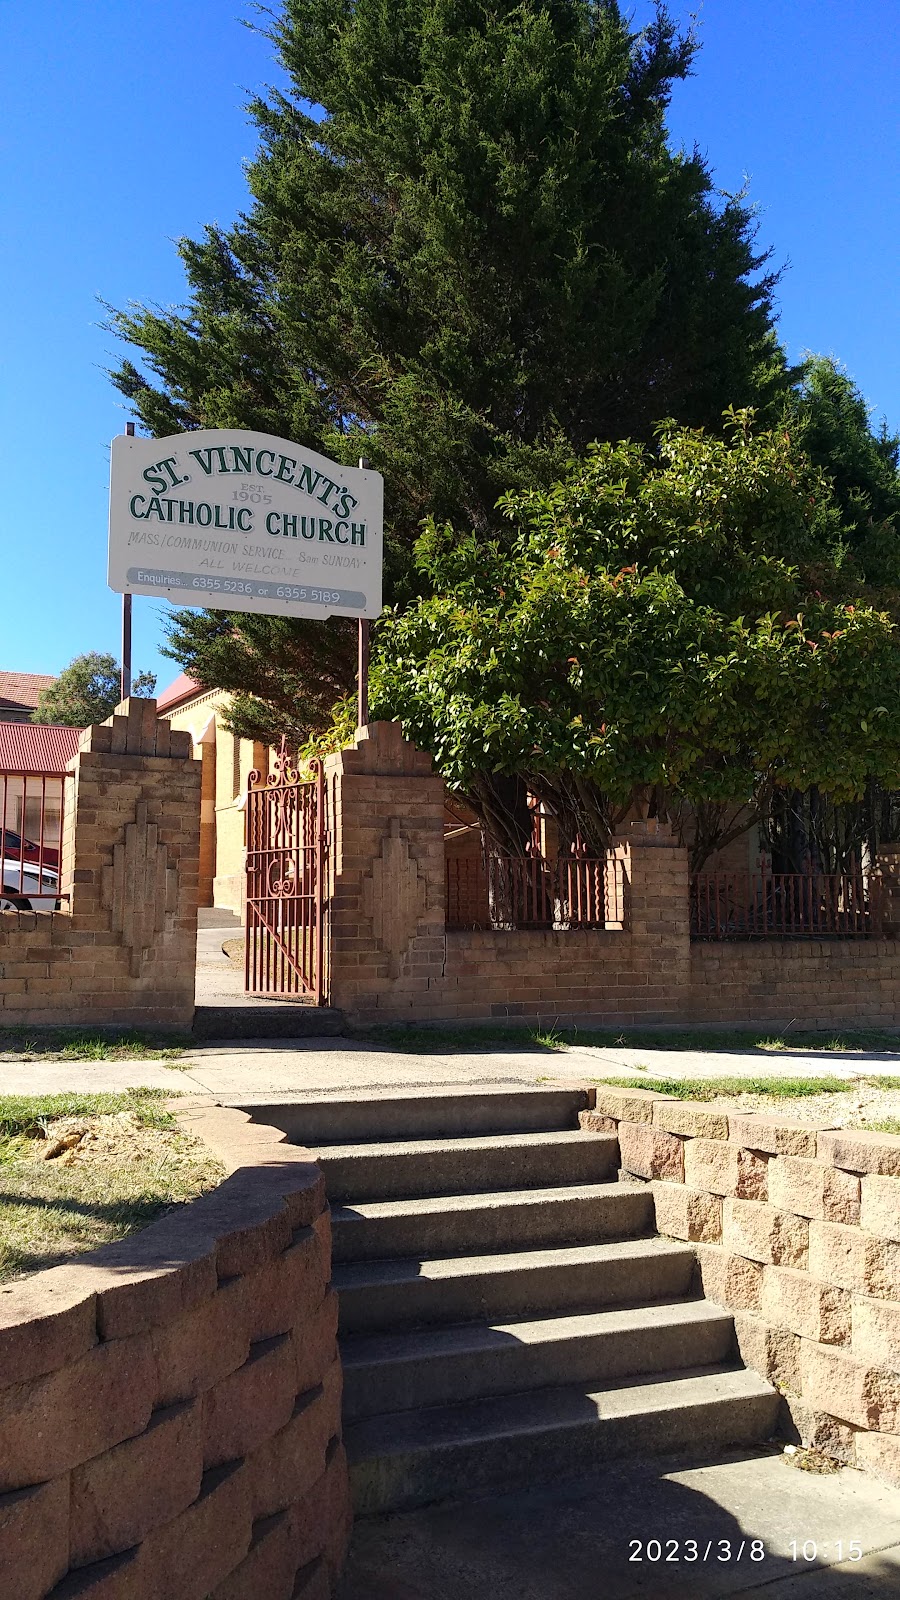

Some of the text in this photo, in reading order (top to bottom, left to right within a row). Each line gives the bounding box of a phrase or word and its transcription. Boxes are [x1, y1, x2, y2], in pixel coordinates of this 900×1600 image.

[143, 446, 358, 519] ST. VINCENT'S
[232, 491, 272, 505] 1905
[130, 495, 366, 546] CATHOLIC CHURCH
[128, 531, 238, 554] MASS/COMMUNION
[322, 554, 362, 569] SUNDAY
[199, 558, 300, 578] ALL WELCOME
[192, 577, 221, 590] 6355
[223, 581, 253, 593] 5236
[276, 586, 307, 599] 6355
[311, 590, 340, 603] 5189
